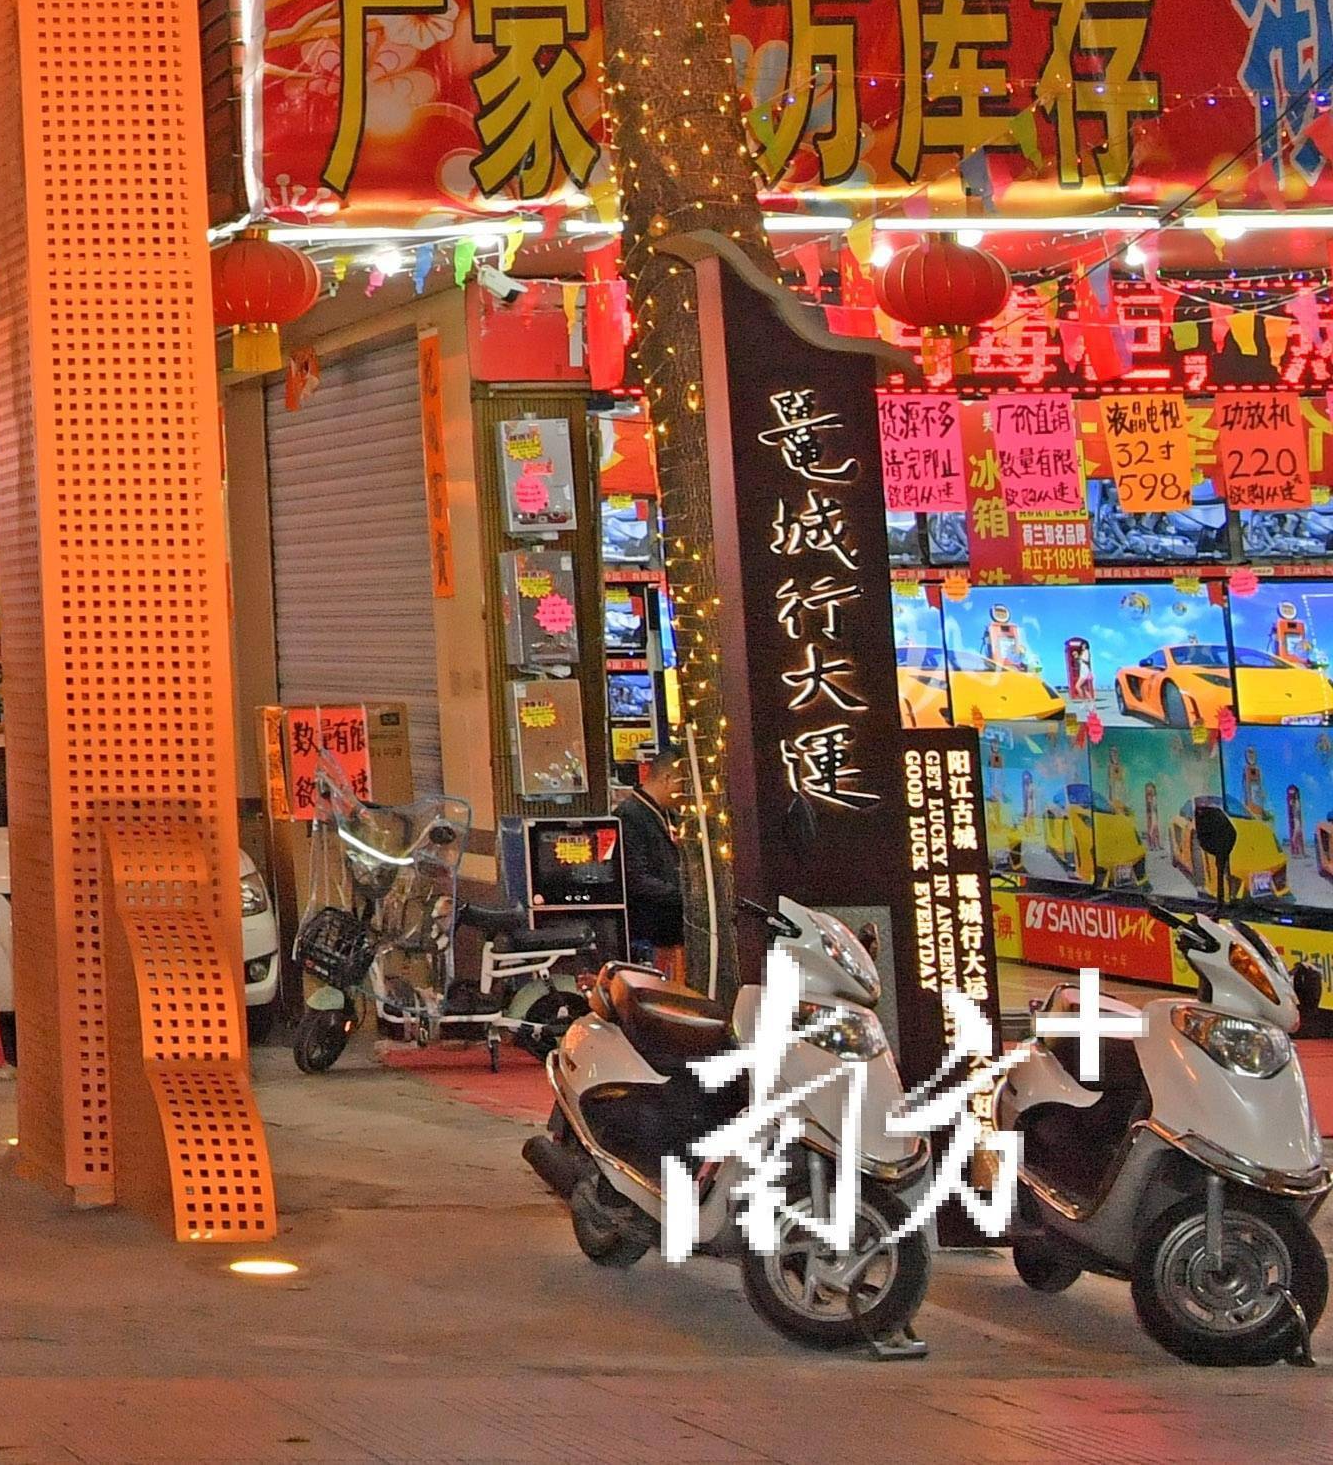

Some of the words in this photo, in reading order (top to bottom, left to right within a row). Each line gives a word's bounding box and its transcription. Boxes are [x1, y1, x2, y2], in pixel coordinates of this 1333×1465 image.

[878, 398, 955, 442] 货源不多
[996, 398, 1071, 436] 厂价直销
[1106, 399, 1183, 438] 液晶电视
[1220, 397, 1296, 432] 功放机
[998, 446, 1076, 479] 数量有限
[1114, 439, 1176, 469] 32寸
[969, 449, 1011, 540] 冰箱
[904, 749, 924, 809] GOOD
[924, 749, 942, 792] GET
[946, 749, 978, 851] 阳江古城
[909, 815, 929, 872] LUCK
[927, 797, 949, 868] LUCKY
[933, 873, 951, 899] IN
[913, 881, 938, 994] EVERYDAY
[1046, 901, 1118, 940] SANSUI
[935, 902, 958, 995] ANCIENT
